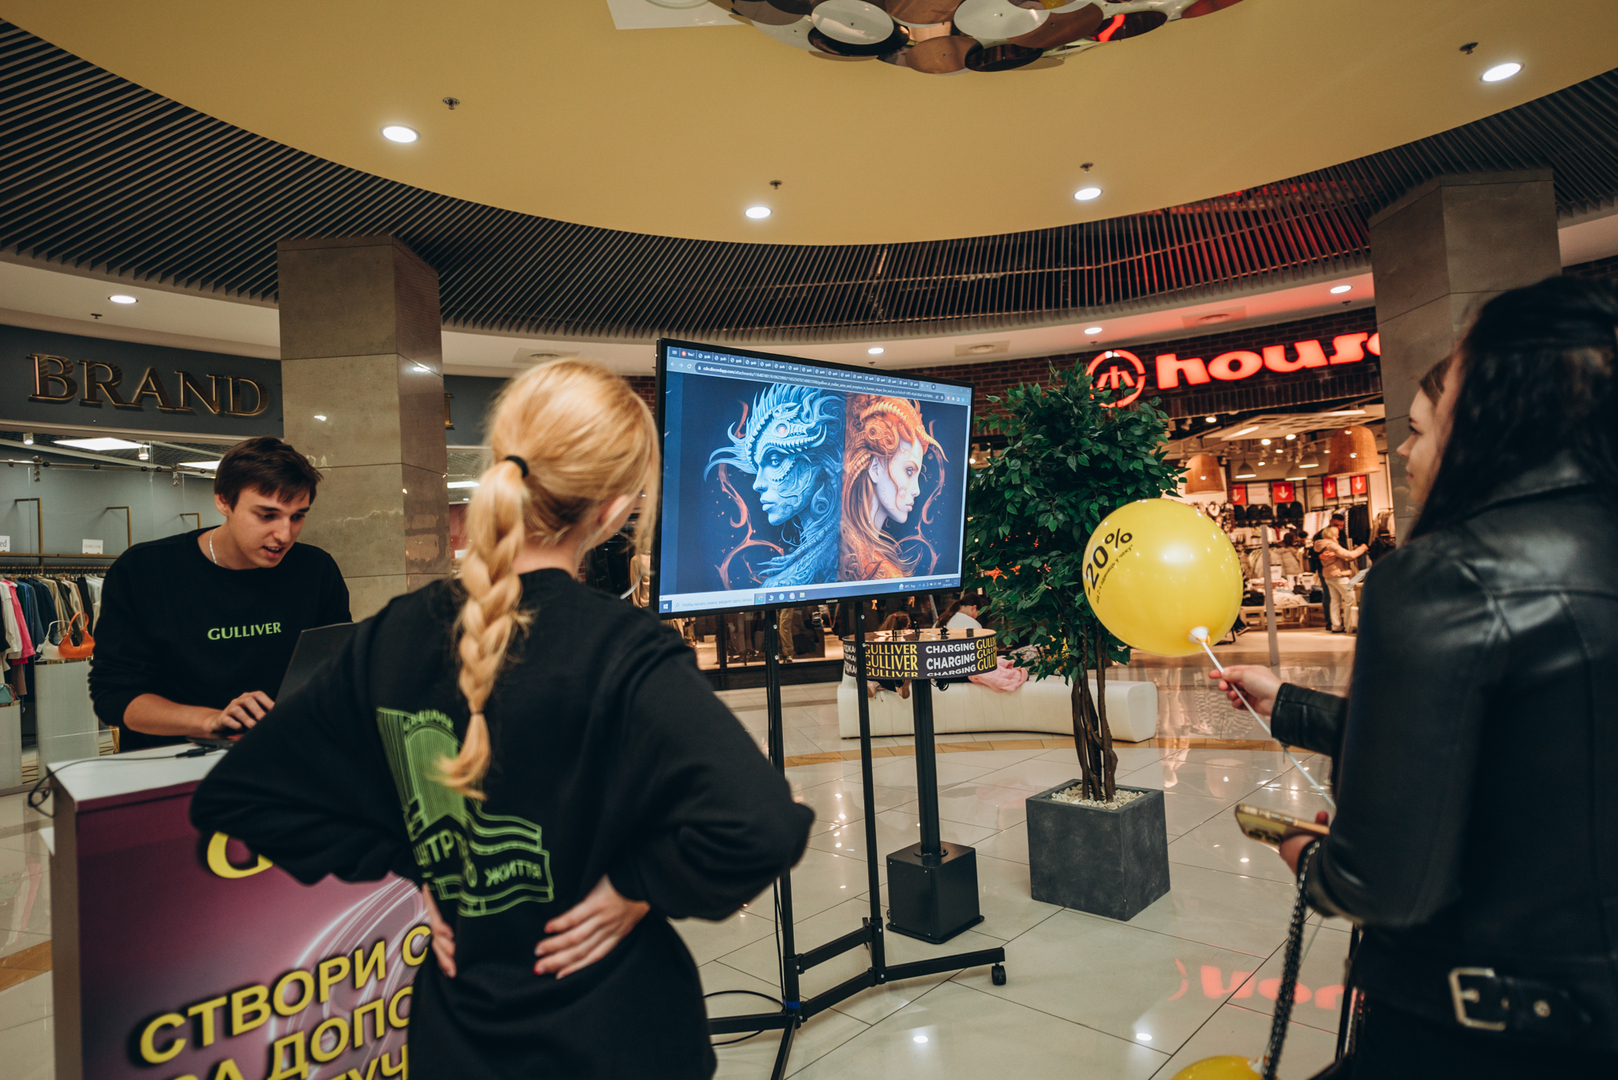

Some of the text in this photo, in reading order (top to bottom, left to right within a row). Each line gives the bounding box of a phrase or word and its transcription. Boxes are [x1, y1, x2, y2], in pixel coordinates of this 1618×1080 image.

[26, 353, 270, 417] BRAND
[1085, 527, 1133, 596] -20%
[207, 621, 282, 640] GULLIVER
[864, 643, 918, 655] GULLIVER
[925, 642, 976, 654] CHARGING
[865, 654, 919, 671] GULLIVER
[925, 652, 976, 670] CHARGING
[865, 666, 919, 678] GULLIVER
[926, 664, 977, 677] CHARGING
[140, 940, 387, 1064] СТВОРИ
